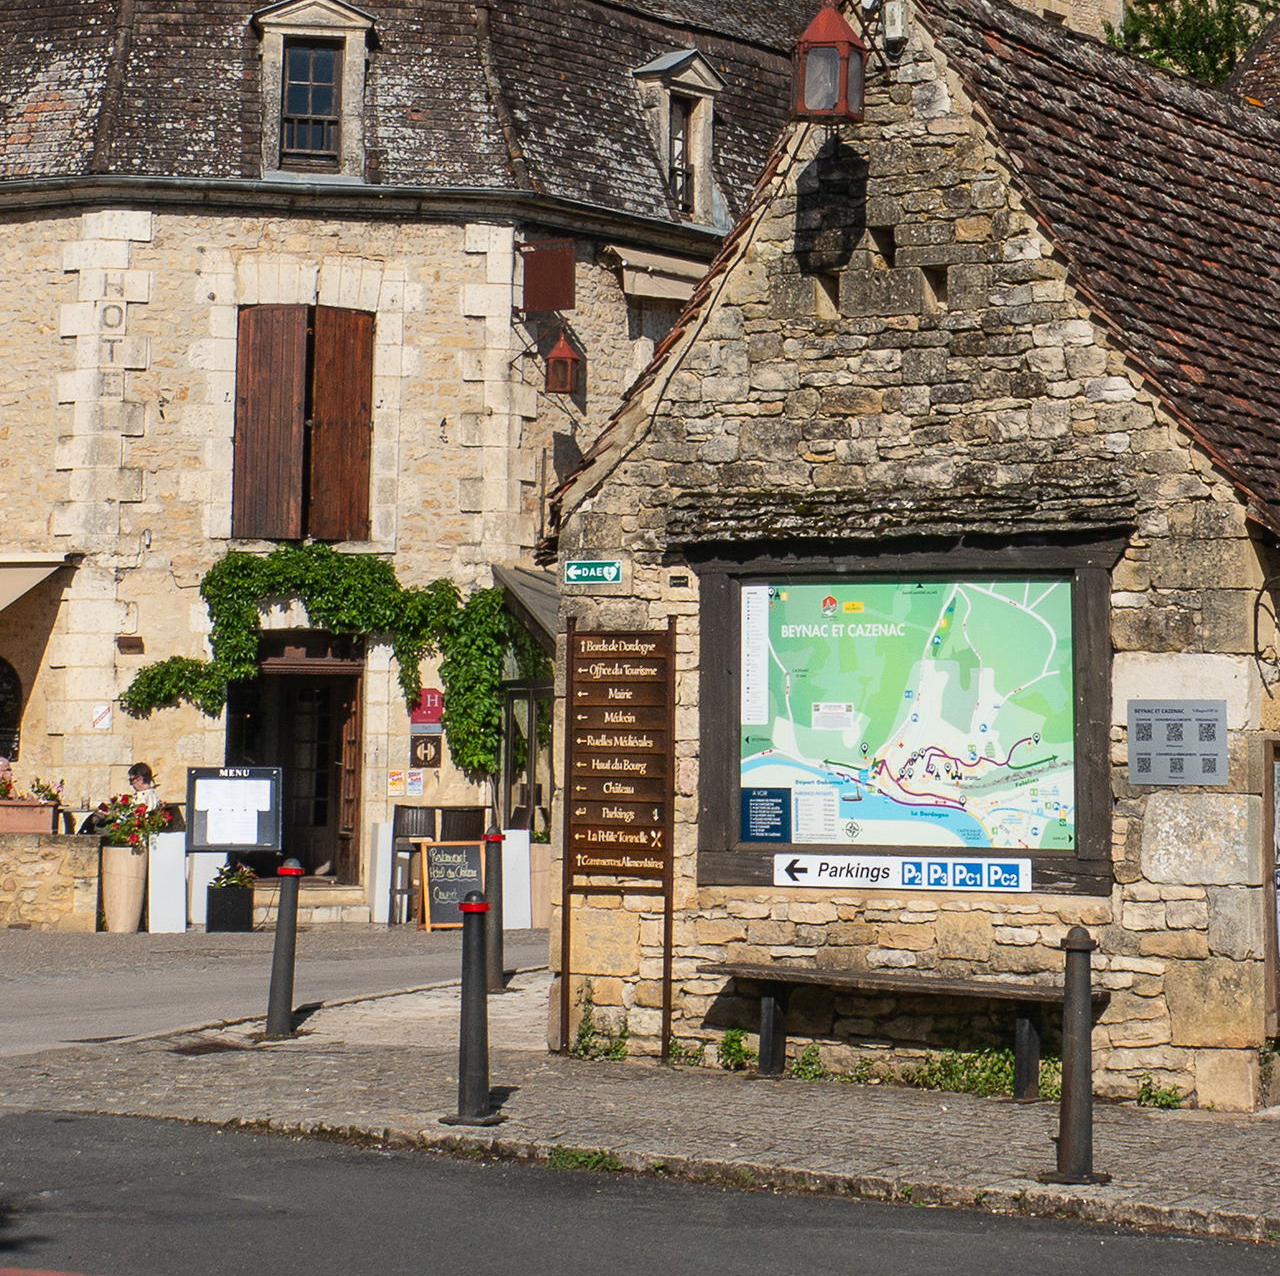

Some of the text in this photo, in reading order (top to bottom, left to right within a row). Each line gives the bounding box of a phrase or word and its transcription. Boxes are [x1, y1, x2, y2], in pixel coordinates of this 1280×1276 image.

[582, 567, 603, 577] DAE
[781, 623, 905, 638] BEYNAC ET CAZENAC
[586, 639, 656, 655] Bords de Dordogne
[589, 663, 657, 679] Office du Tourisme
[427, 694, 439, 707] H
[608, 687, 633, 699] Mairie
[219, 769, 249, 777] MENU
[591, 758, 647, 775] Haut du Bourg
[602, 806, 635, 823] Parkings
[587, 830, 597, 842] La
[817, 862, 890, 883] Parkings
[903, 864, 922, 884] P2
[929, 864, 947, 885] P3
